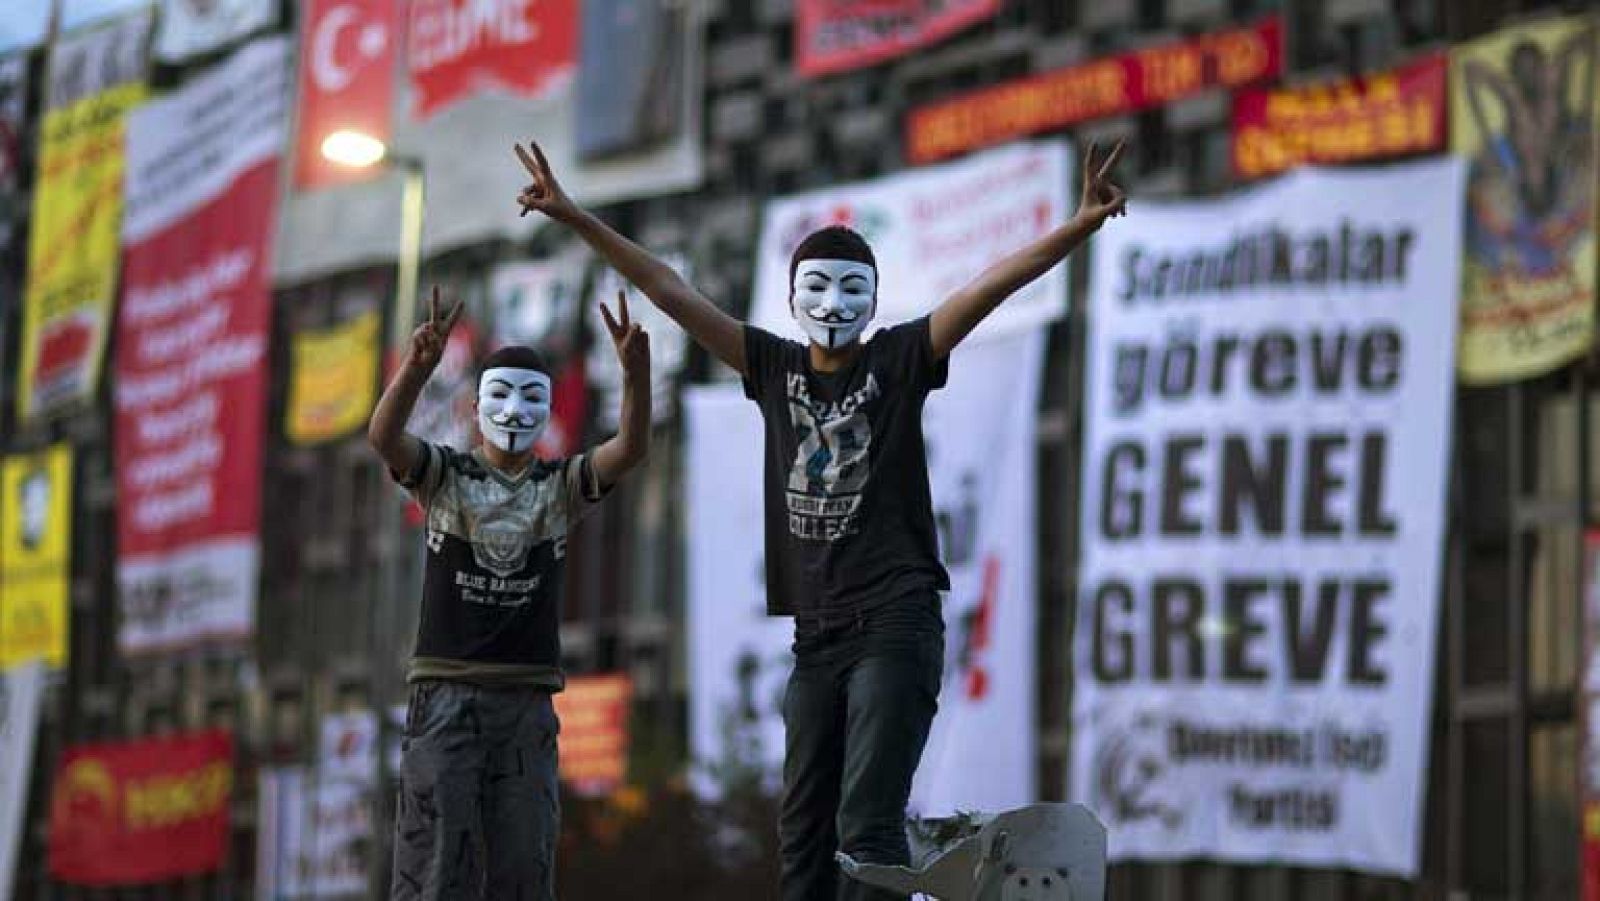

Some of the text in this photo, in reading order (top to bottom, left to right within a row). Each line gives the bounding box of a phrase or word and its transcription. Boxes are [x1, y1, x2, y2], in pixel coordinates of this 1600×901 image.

[1120, 218, 1413, 301] Sendikalar
[1115, 322, 1402, 414] göreve
[1102, 432, 1396, 541] GENEL
[1093, 576, 1389, 684] GREVE
